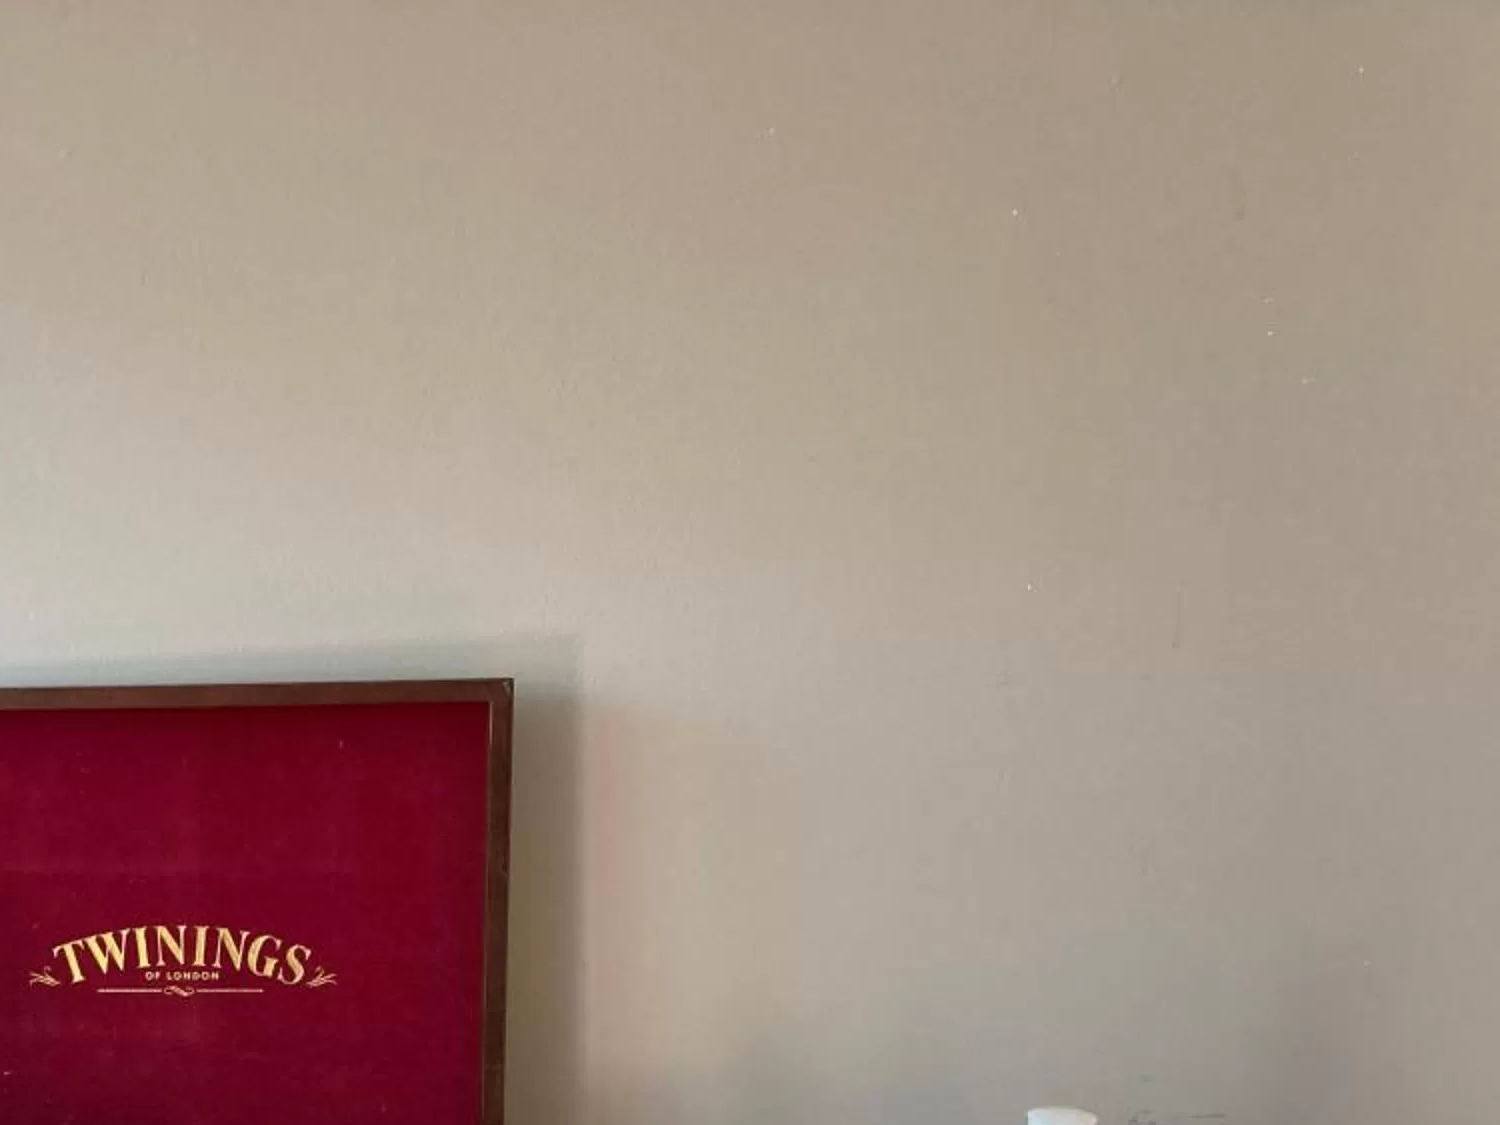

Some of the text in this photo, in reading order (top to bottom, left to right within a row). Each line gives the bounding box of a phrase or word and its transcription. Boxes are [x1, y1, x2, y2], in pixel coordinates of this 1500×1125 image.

[53, 925, 312, 985] TWININGS
[145, 971, 220, 981] OF LONDON
